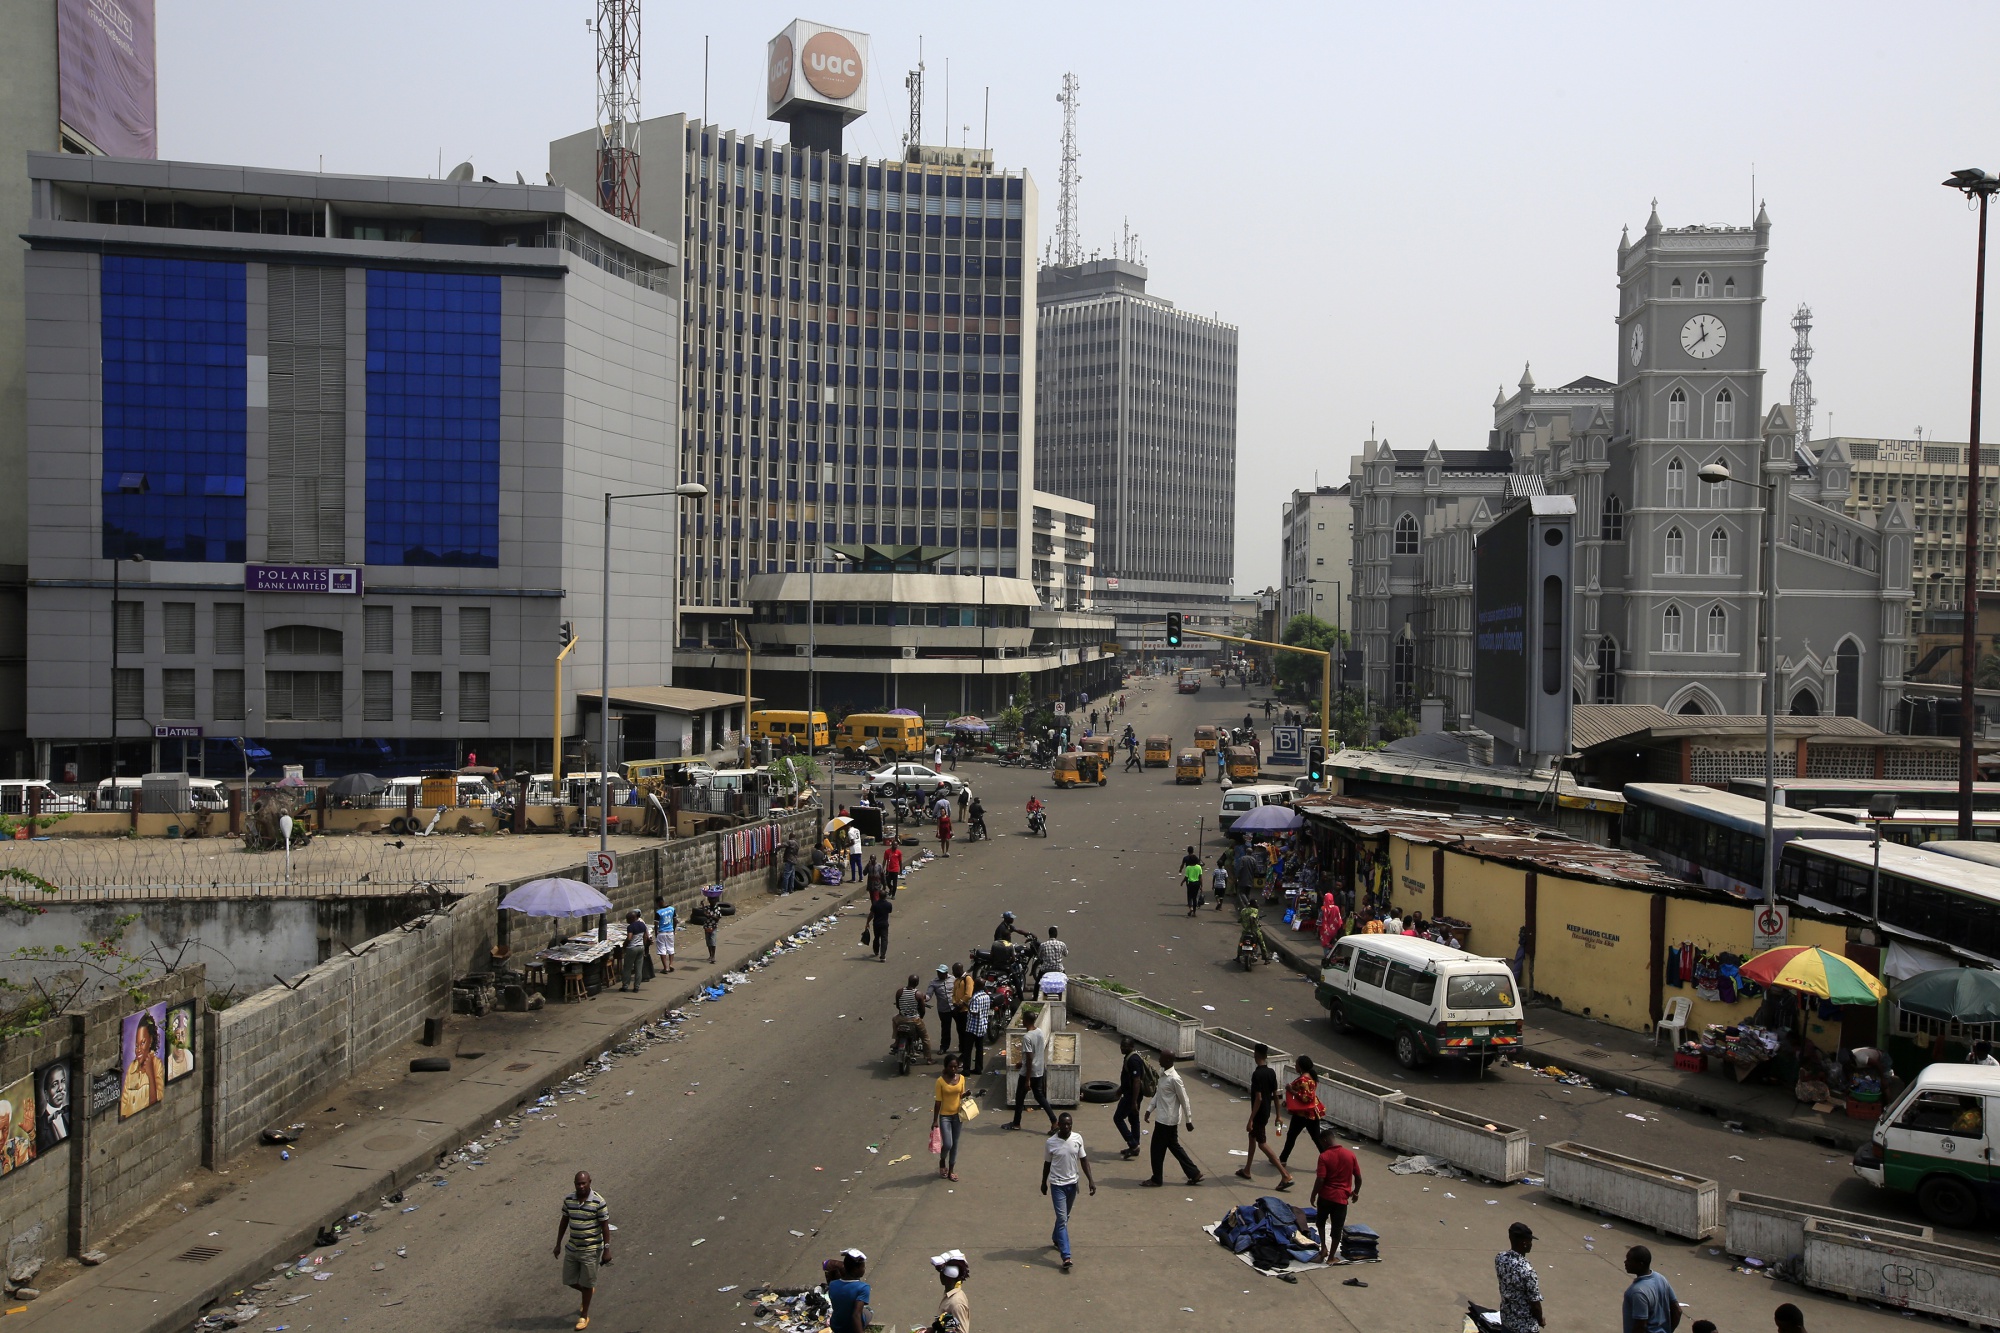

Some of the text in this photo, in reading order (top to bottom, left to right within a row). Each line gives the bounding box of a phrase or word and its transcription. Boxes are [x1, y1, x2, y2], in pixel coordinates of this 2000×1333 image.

[771, 57, 789, 82] uac
[811, 52, 856, 77] uac
[258, 570, 327, 581] POLARIS
[258, 581, 327, 591] BANK LIMITED
[1566, 923, 1580, 932] KEEP
[1601, 932, 1620, 942] CLEAN
[1882, 1264, 1934, 1292] CBD
